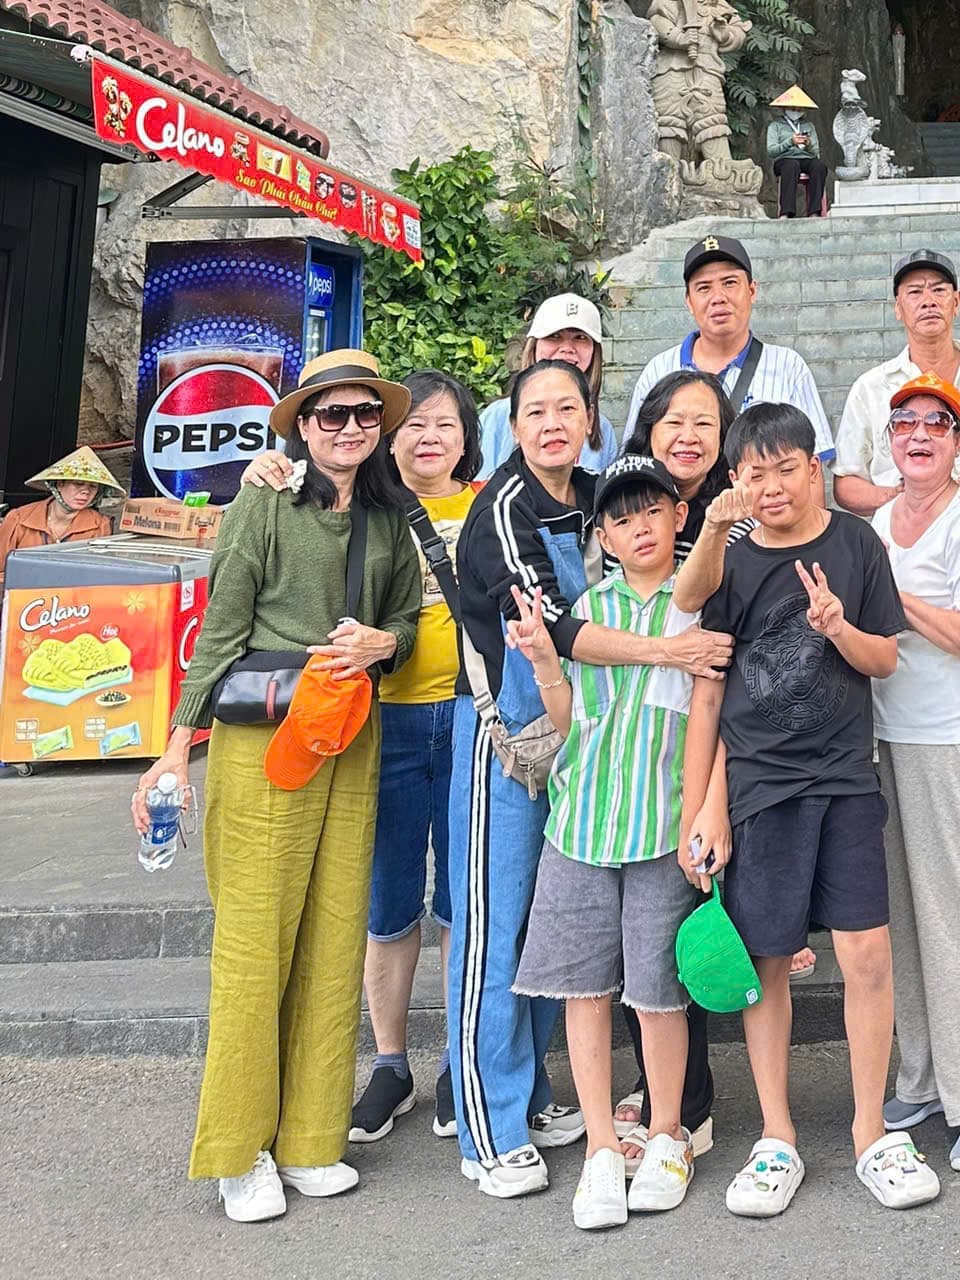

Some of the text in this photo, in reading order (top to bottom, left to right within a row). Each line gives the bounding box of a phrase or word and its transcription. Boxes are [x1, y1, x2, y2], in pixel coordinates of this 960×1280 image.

[136, 97, 225, 157] Celano
[235, 168, 256, 188] Sao
[313, 276, 332, 296] pepsi
[153, 422, 276, 453] PEPSI
[605, 455, 655, 480] NEW YORK
[19, 595, 91, 632] Celano
